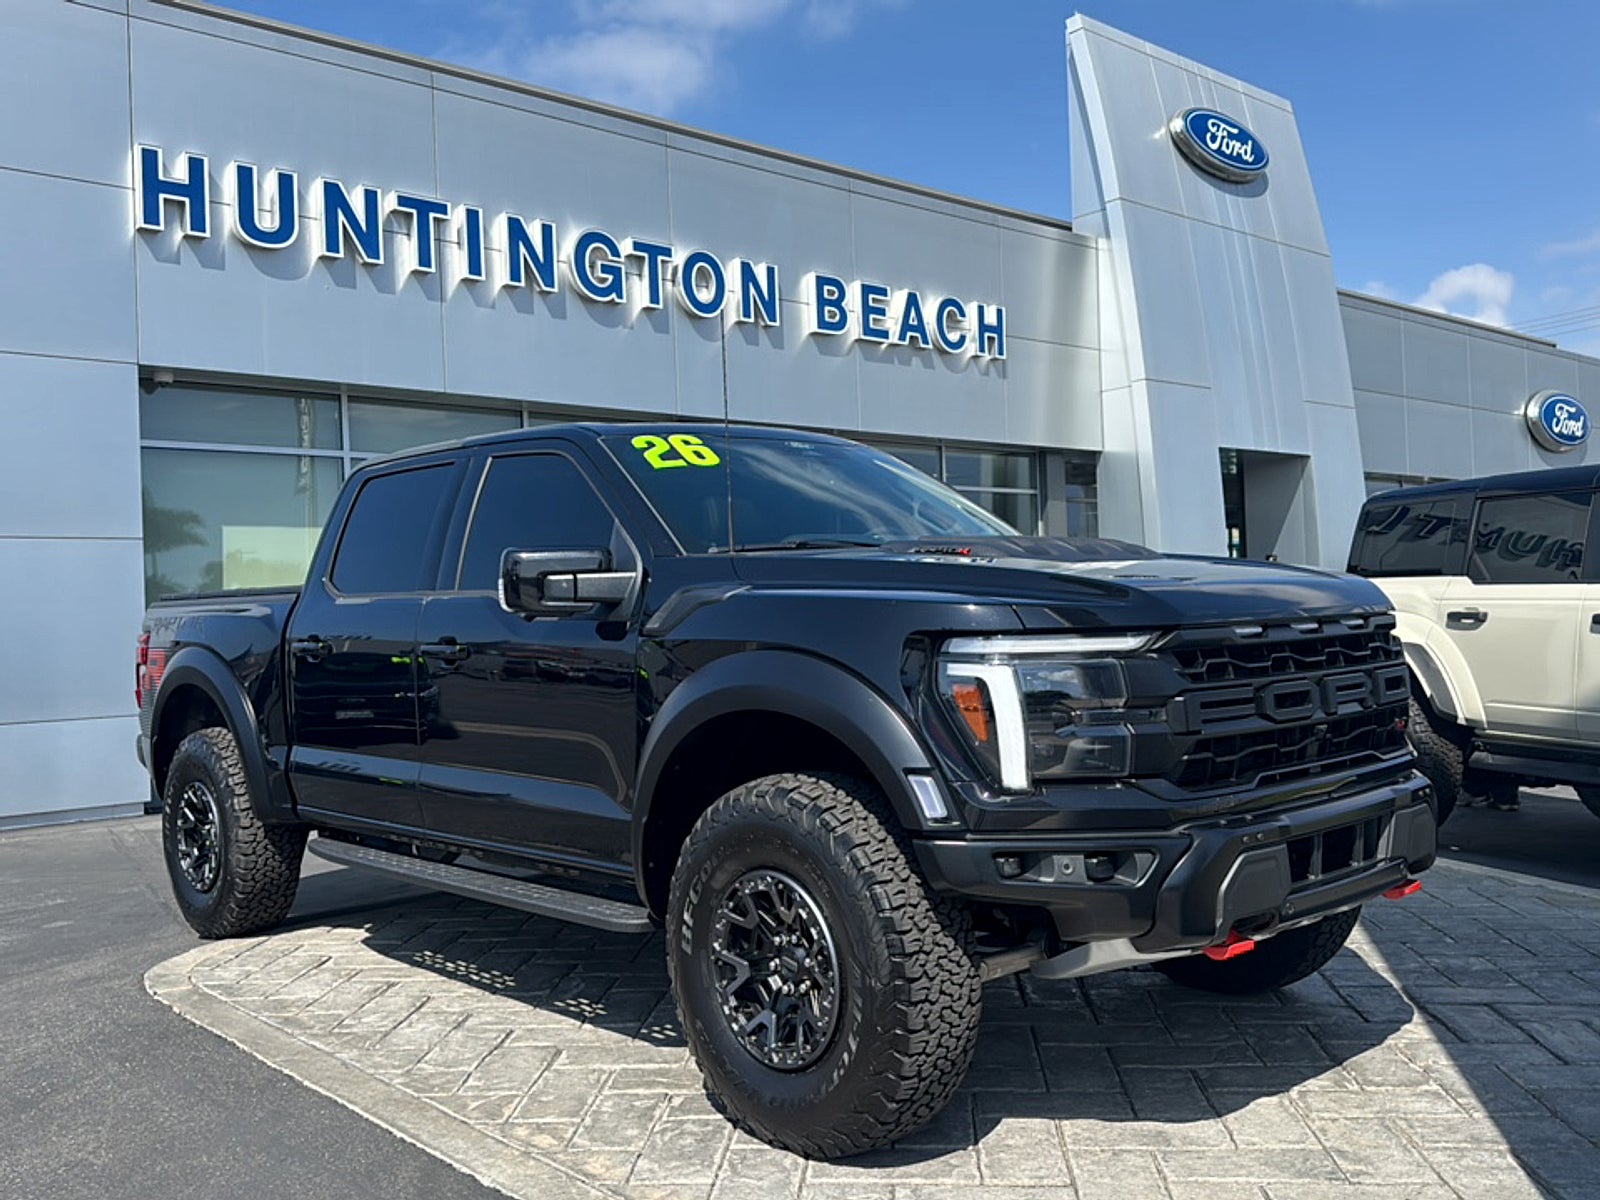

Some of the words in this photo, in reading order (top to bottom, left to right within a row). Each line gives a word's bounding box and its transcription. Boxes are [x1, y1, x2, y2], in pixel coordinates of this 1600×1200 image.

[1206, 118, 1255, 163] Ford
[137, 144, 780, 327] HUNTINGTON
[809, 271, 1007, 360] BEACH
[1551, 402, 1585, 438] Ford
[631, 433, 721, 471] 26
[1169, 664, 1411, 735] FORD
